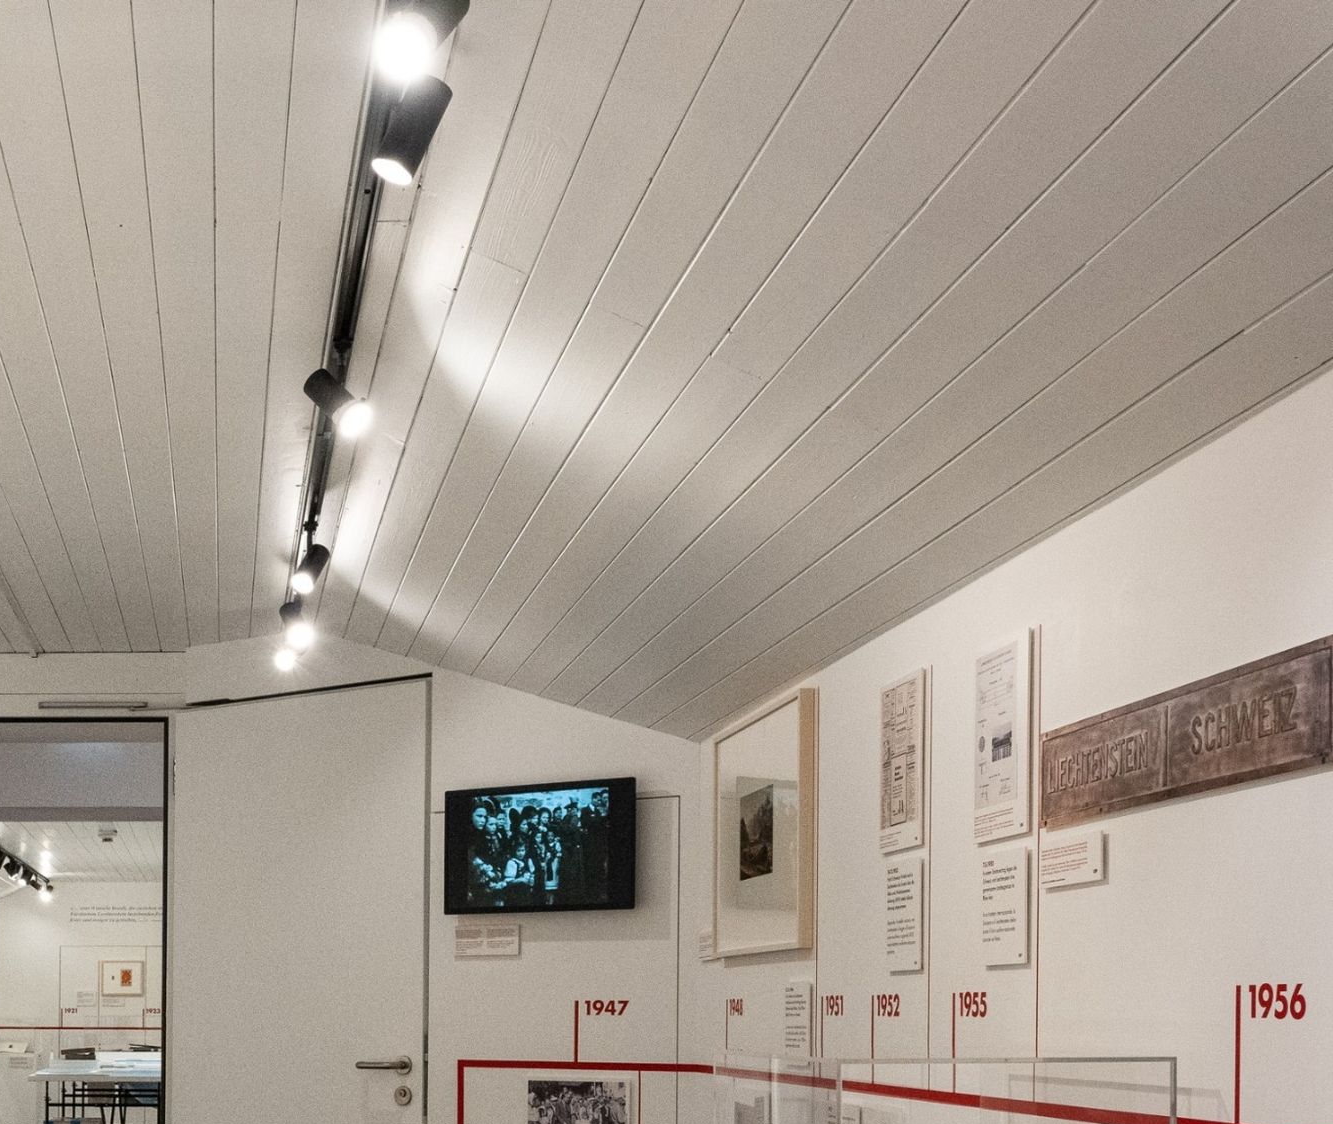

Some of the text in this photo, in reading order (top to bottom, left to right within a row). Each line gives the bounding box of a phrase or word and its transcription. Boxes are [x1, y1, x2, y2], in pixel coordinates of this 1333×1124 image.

[1047, 686, 1298, 794] LIECHTENSTEIN SCHWEIZ
[583, 1000, 629, 1017] 1947
[825, 995, 844, 1017] 1951
[876, 993, 901, 1018] 1952
[959, 991, 988, 1018] 1955
[1248, 983, 1307, 1020] 1956
